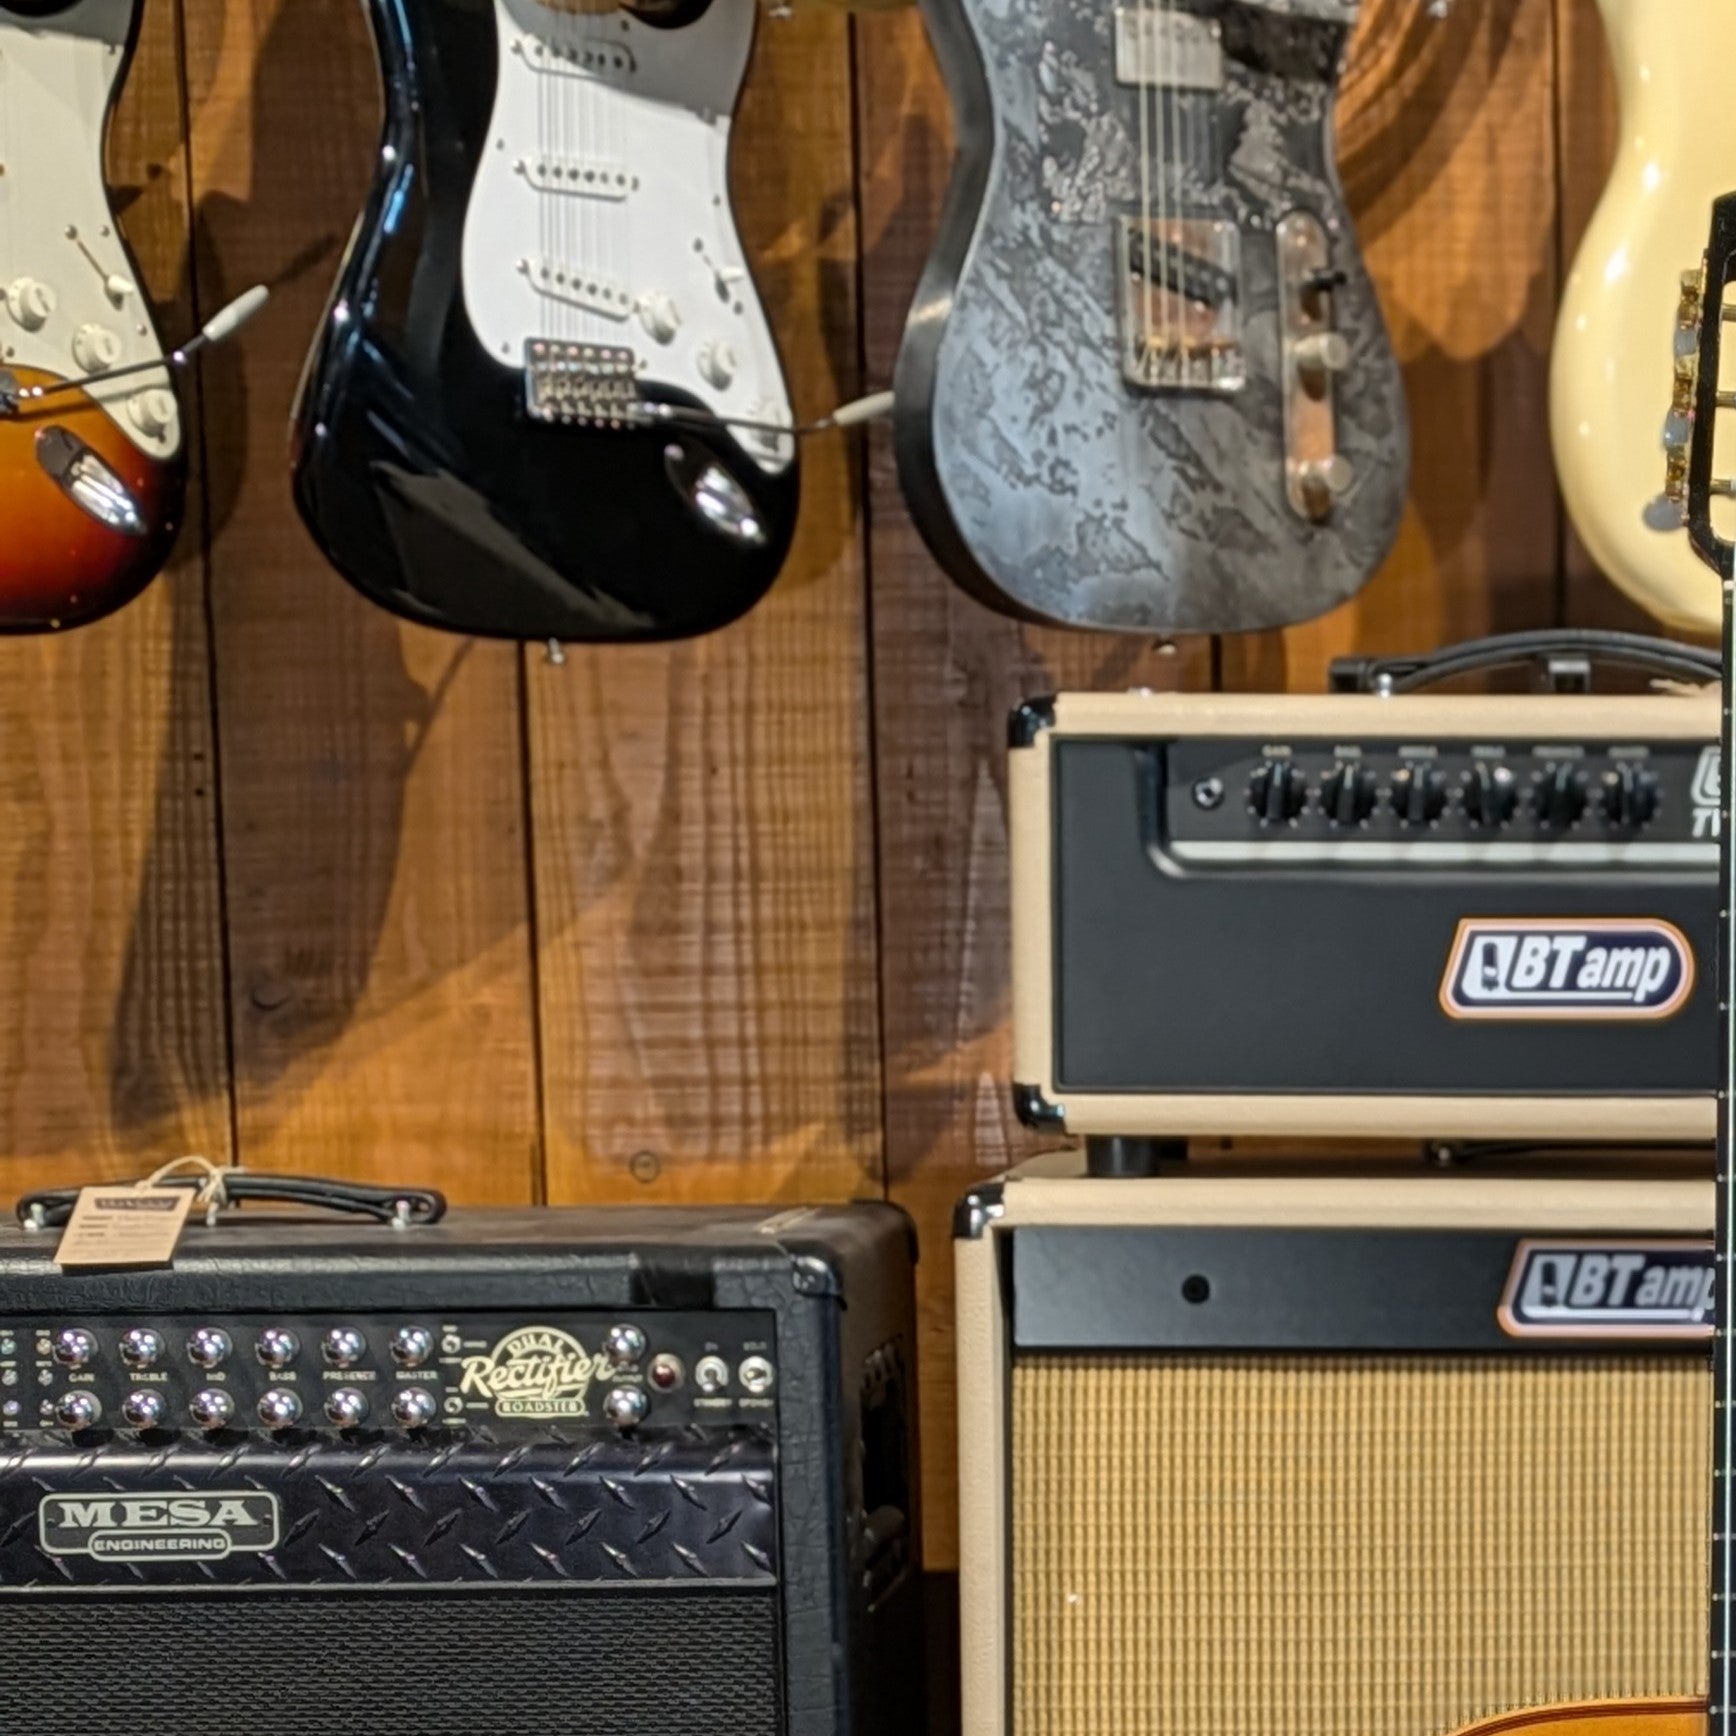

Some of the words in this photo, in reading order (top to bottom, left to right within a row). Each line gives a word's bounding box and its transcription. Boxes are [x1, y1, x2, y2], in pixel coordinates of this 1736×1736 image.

[505, 1333, 566, 1357] DUAL
[460, 1352, 616, 1400] Rectifier
[501, 1400, 580, 1413] ROADSTER
[57, 1499, 259, 1528] MESA
[93, 1537, 227, 1552] ENGINEERING
